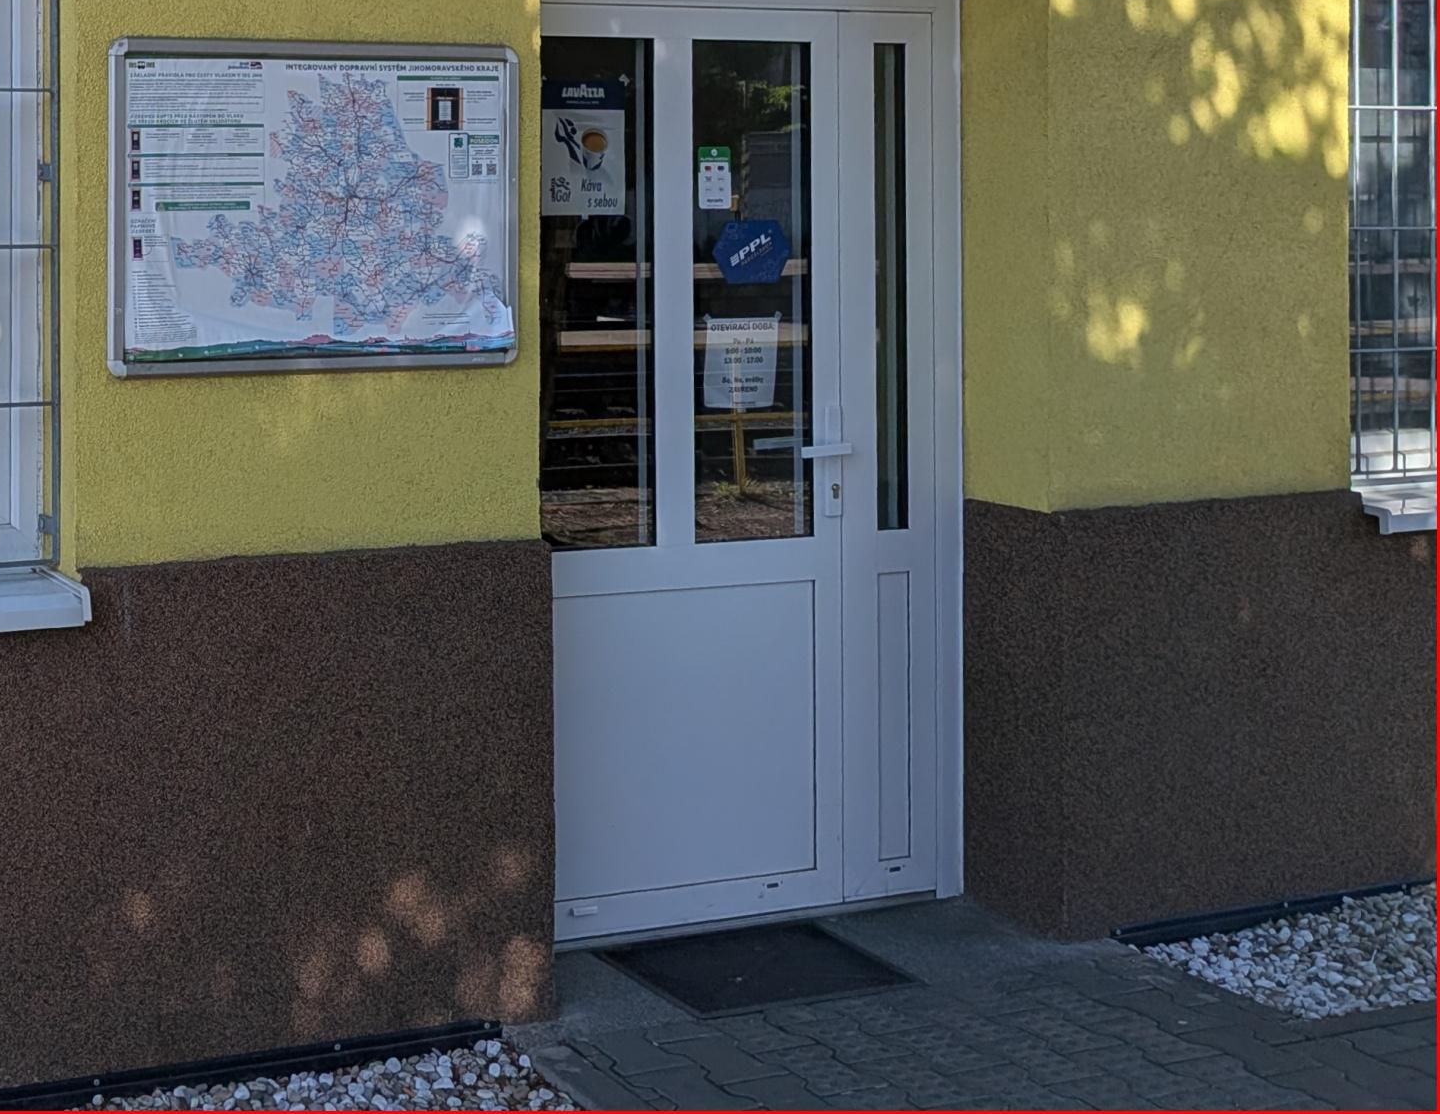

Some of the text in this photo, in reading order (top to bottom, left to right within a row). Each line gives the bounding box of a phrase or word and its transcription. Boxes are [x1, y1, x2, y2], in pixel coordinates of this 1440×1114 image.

[476, 64, 499, 73] KRAJE
[561, 84, 606, 99] LAVAZZA
[580, 178, 602, 192] Káva
[587, 192, 618, 208] s sebou
[739, 234, 772, 260] PPL
